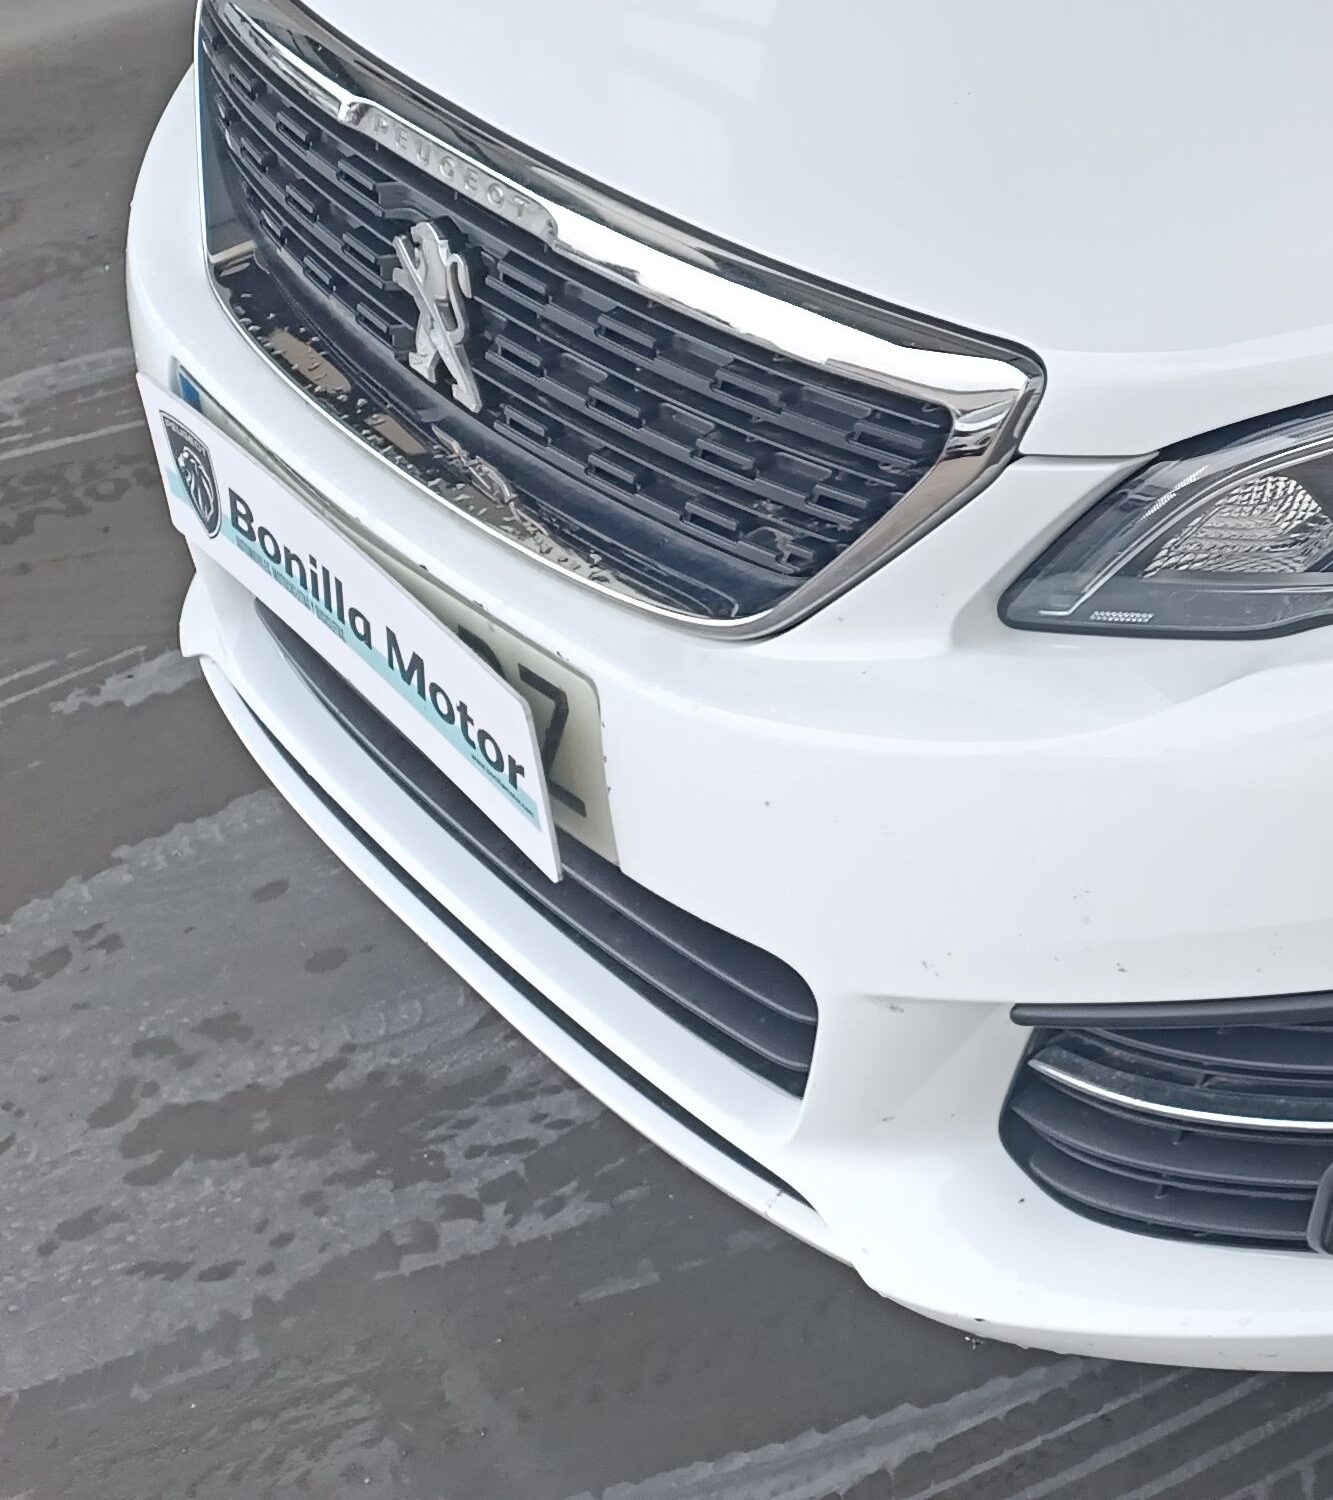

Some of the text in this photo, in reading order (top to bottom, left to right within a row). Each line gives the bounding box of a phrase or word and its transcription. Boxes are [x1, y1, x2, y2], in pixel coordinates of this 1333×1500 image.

[373, 112, 531, 218] PEUGEOT
[228, 487, 372, 650] Bonilla
[386, 626, 525, 790] Motor
